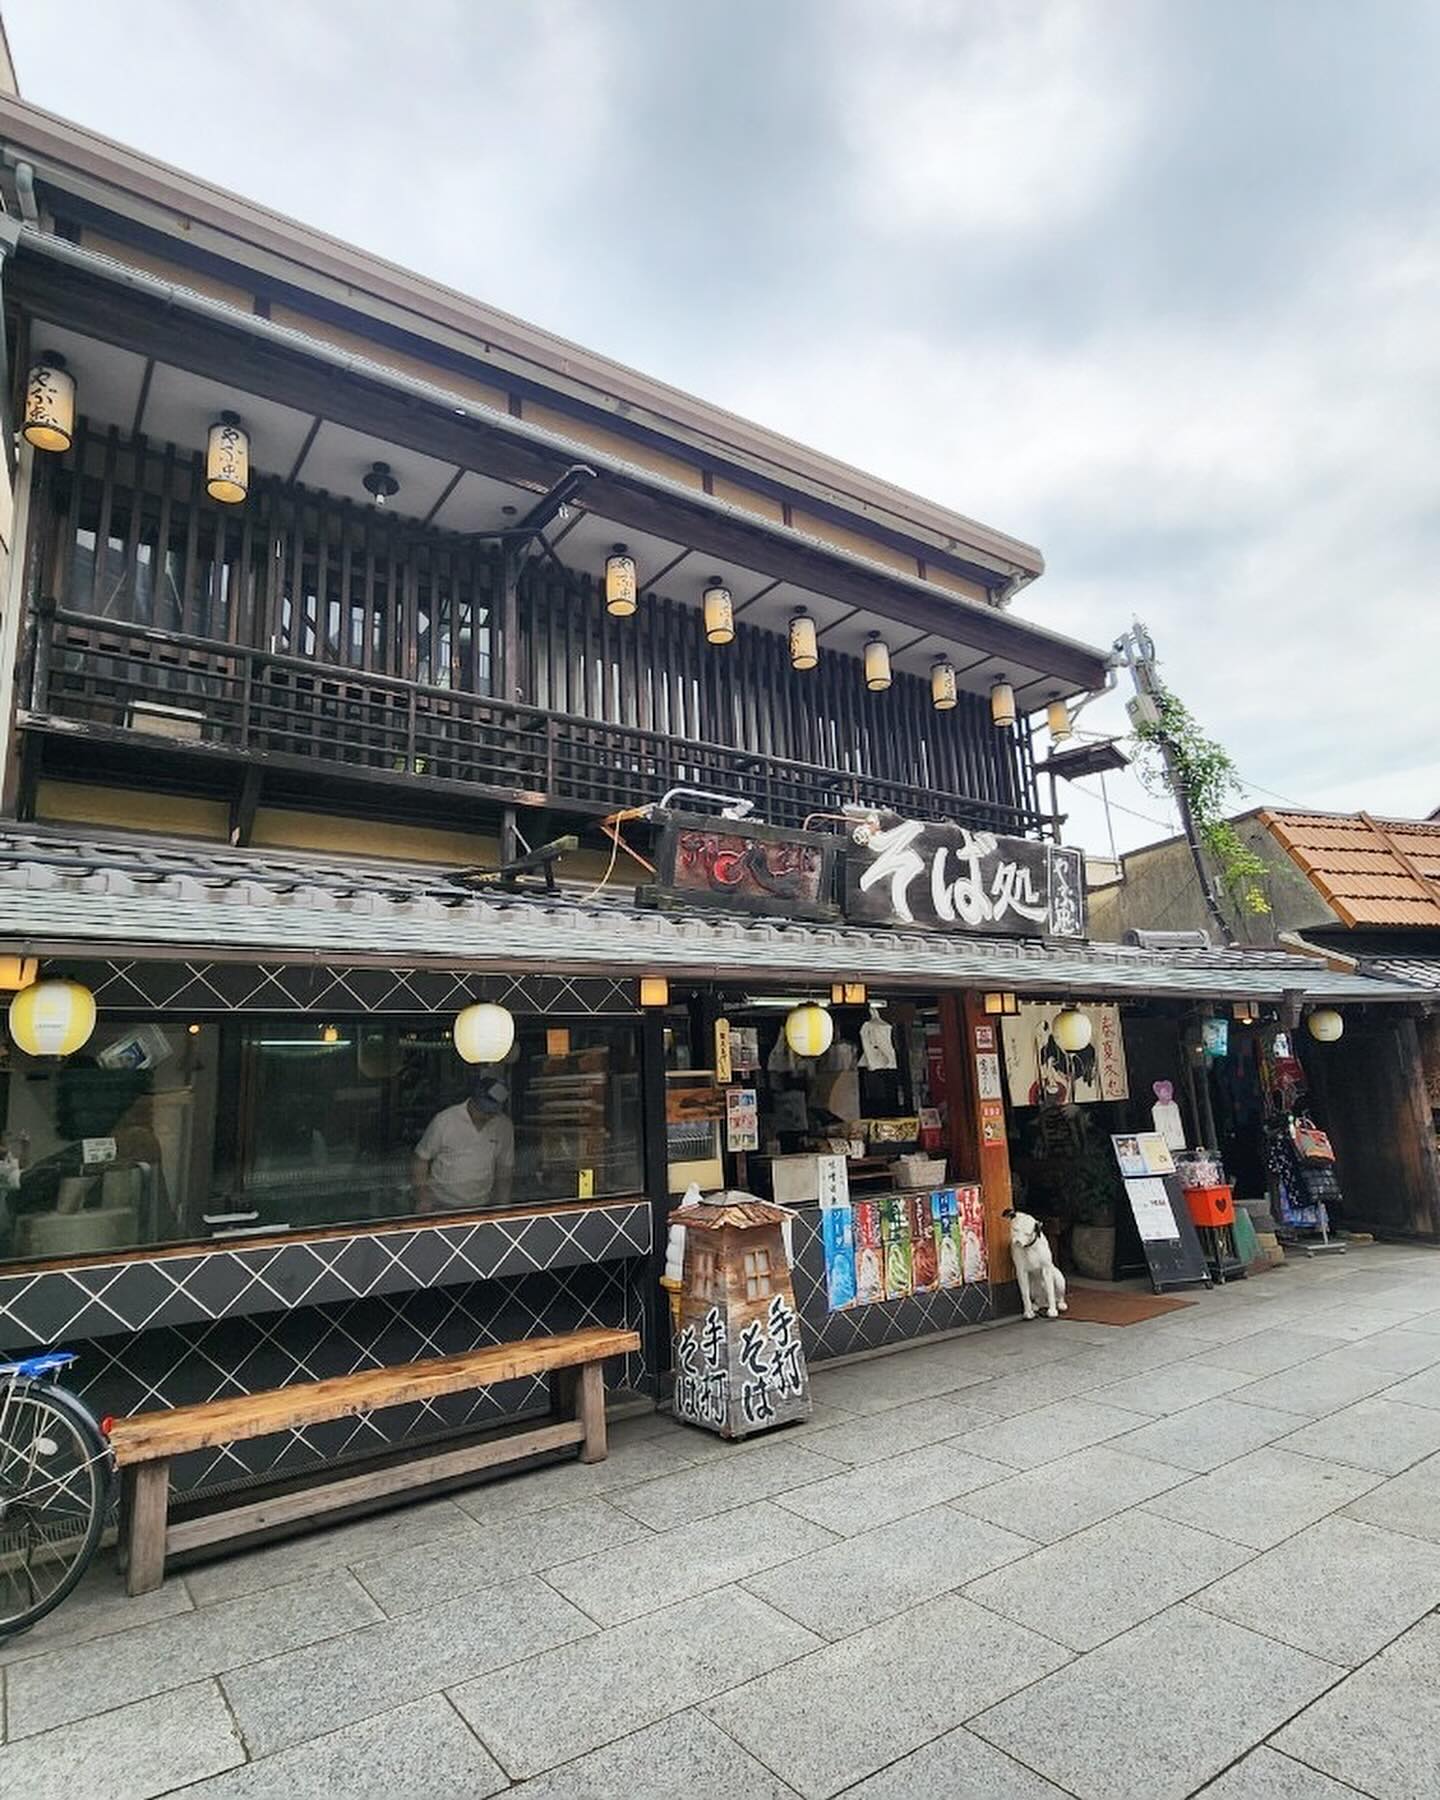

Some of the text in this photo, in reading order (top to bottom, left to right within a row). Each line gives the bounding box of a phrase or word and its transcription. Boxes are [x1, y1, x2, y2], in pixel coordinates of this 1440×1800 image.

[859, 819, 1050, 926] そば処
[677, 1323, 701, 1420] そば
[701, 1305, 728, 1427] 手打
[739, 1319, 778, 1423] そば
[768, 1294, 802, 1399] 手打
